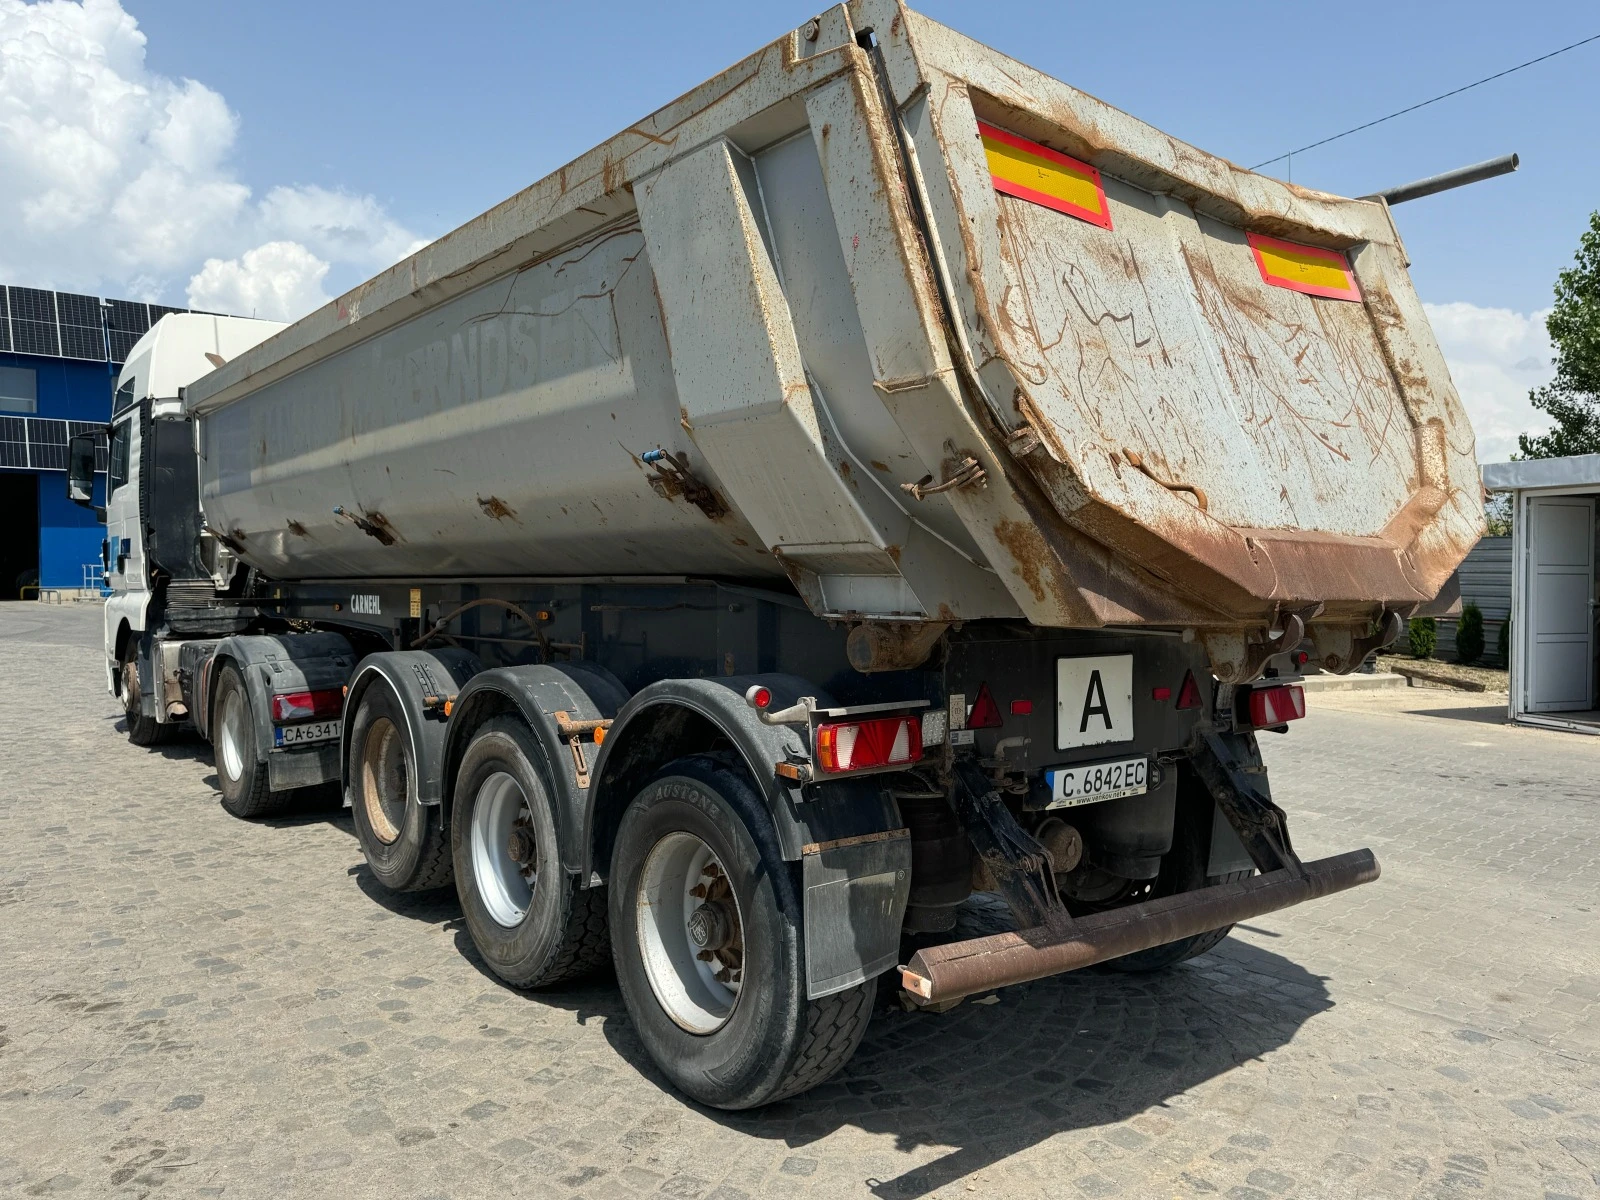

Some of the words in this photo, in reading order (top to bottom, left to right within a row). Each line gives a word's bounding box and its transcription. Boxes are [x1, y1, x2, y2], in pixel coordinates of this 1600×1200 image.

[351, 594, 381, 615] CARNEHL
[1079, 669, 1113, 733] A
[655, 783, 720, 820] AUSTONE
